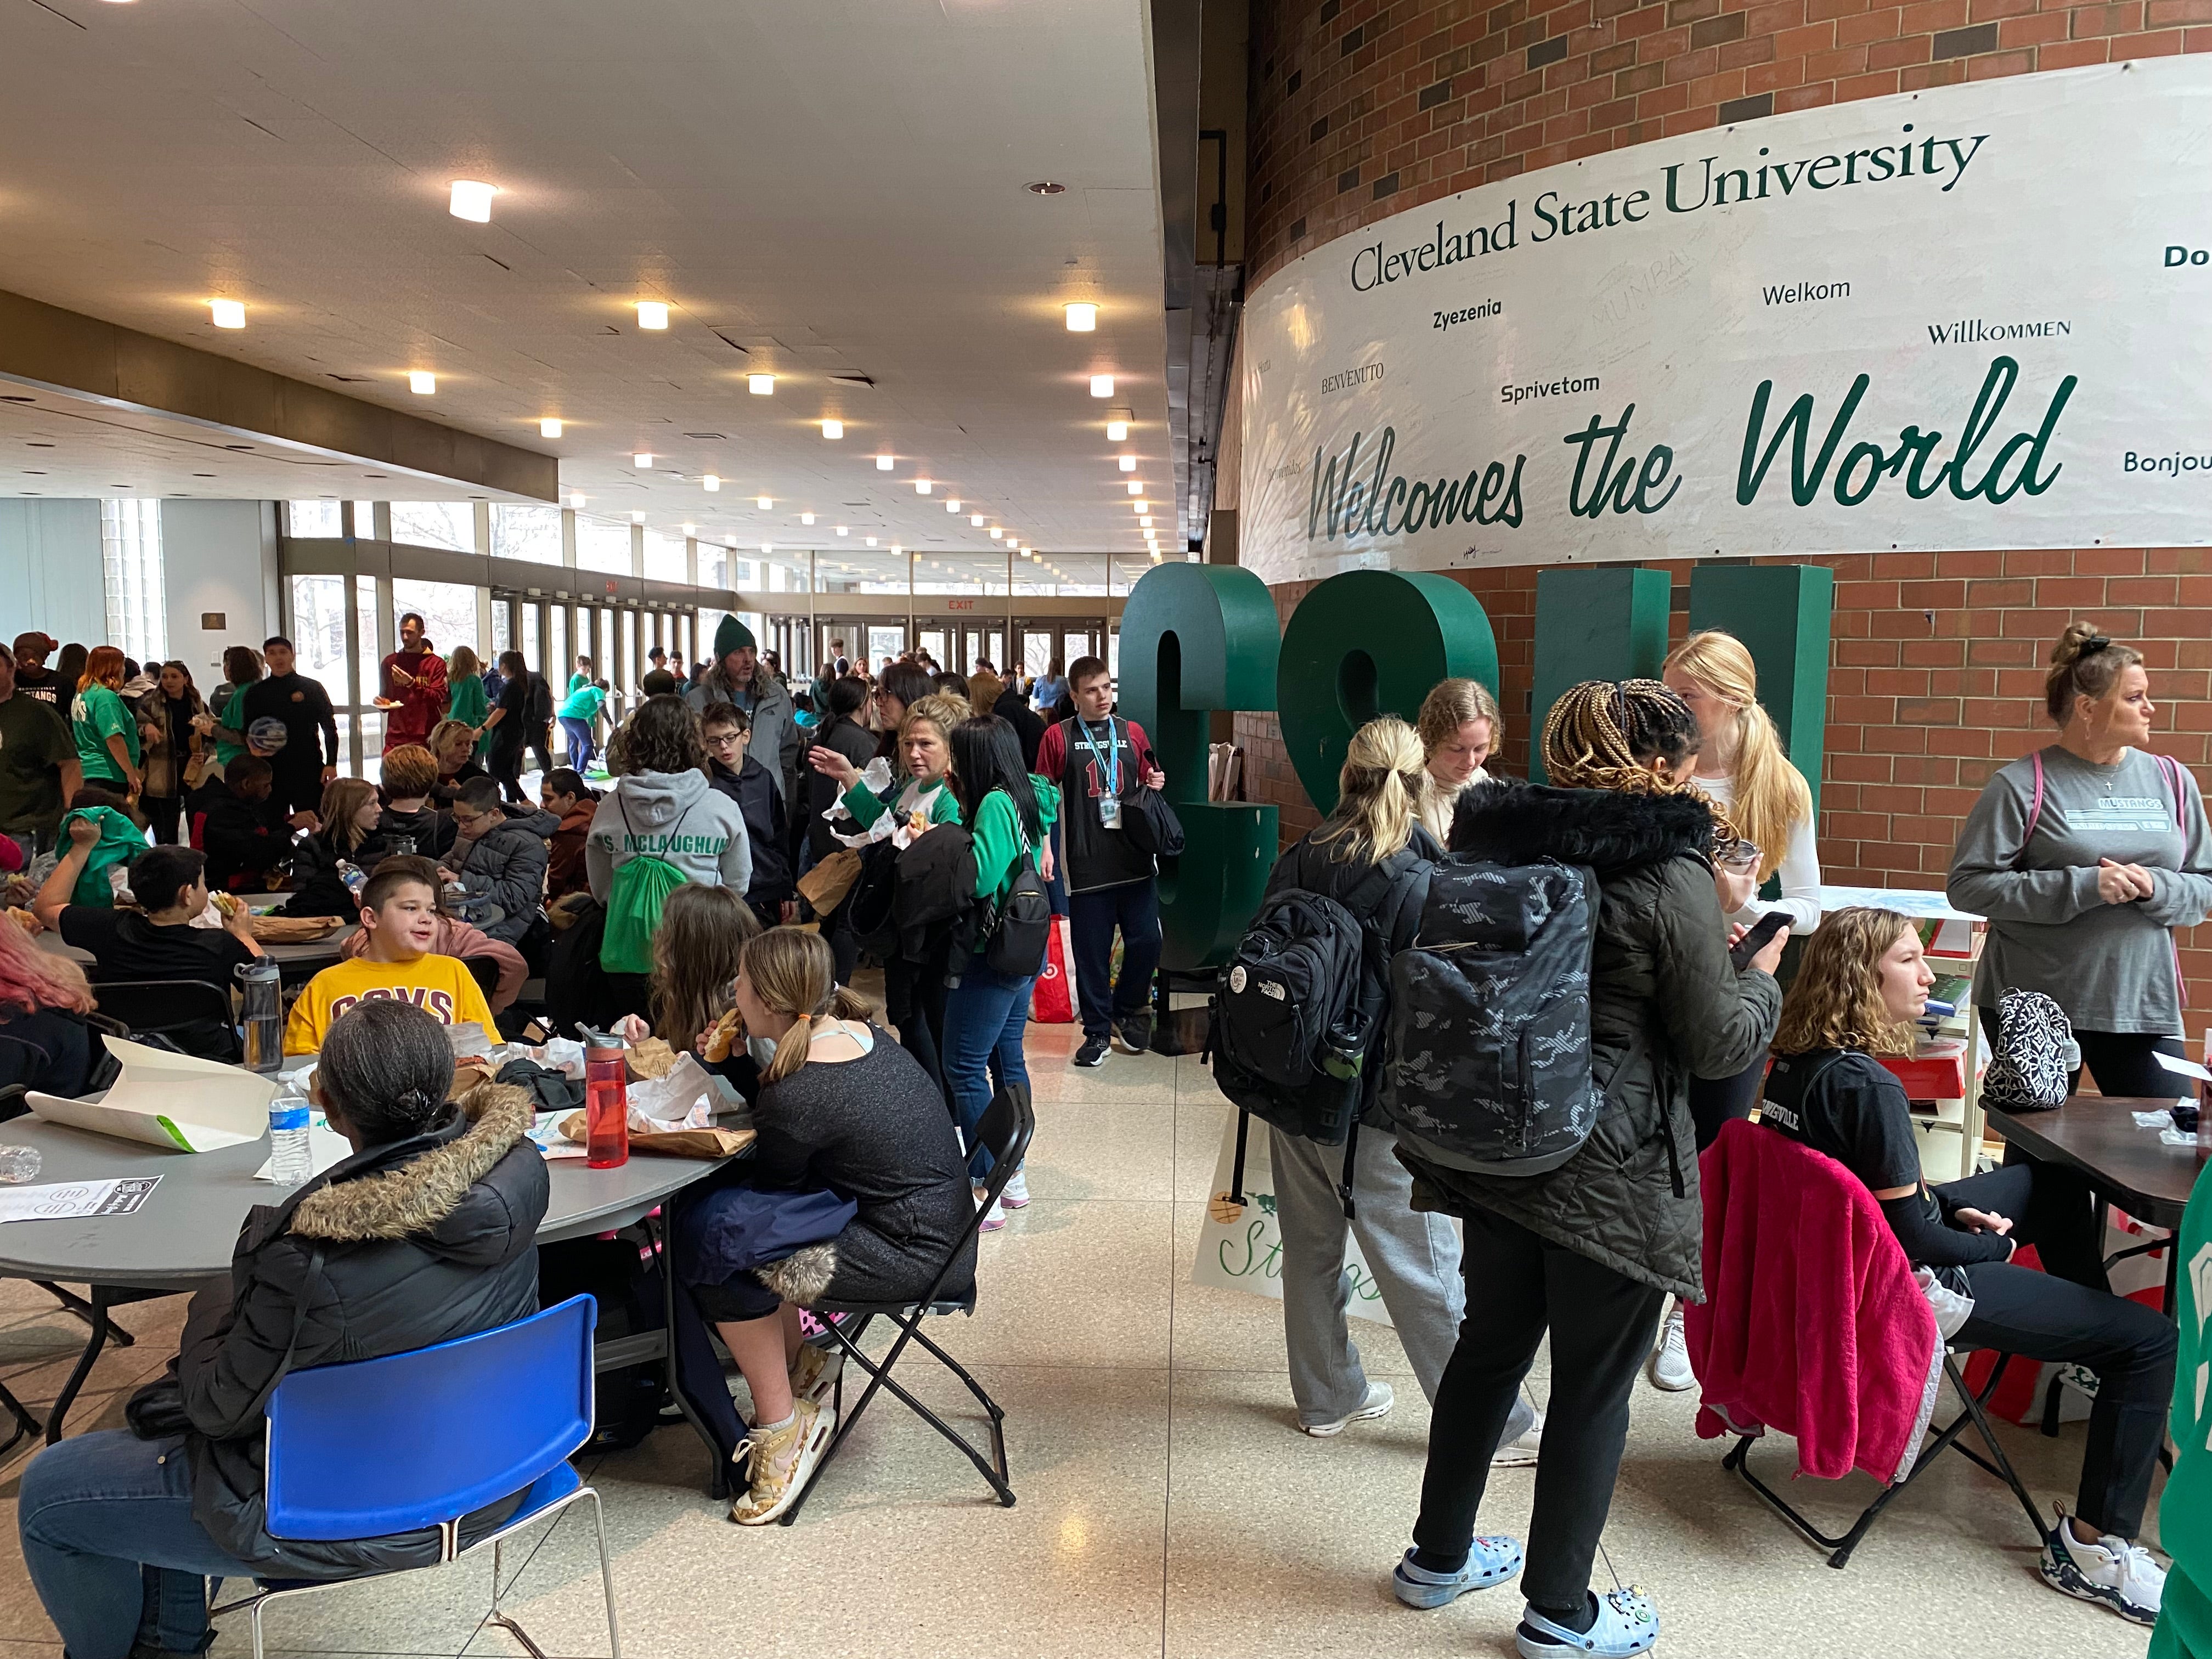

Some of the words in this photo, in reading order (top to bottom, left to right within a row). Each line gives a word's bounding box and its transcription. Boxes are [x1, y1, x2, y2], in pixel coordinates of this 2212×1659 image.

[1352, 200, 1519, 291] Cleveland
[1531, 191, 1650, 242] State
[1660, 123, 1991, 213] University
[1762, 281, 1850, 306] Welkom
[1434, 298, 1502, 332] Zyezenia
[1322, 362, 1384, 395] BENVENUTO
[1501, 376, 1600, 405] Sprivetom
[1307, 426, 1527, 542] Welcomes
[1564, 403, 1682, 520] the
[1736, 355, 2078, 507] World
[2124, 451, 2212, 477] Bonjou
[948, 600, 974, 610] EXIT
[2098, 798, 2164, 810] MUSTANGS
[1257, 981, 1277, 992] NORTH
[1261, 988, 1275, 996] FACE
[1267, 979, 1278, 988] THE
